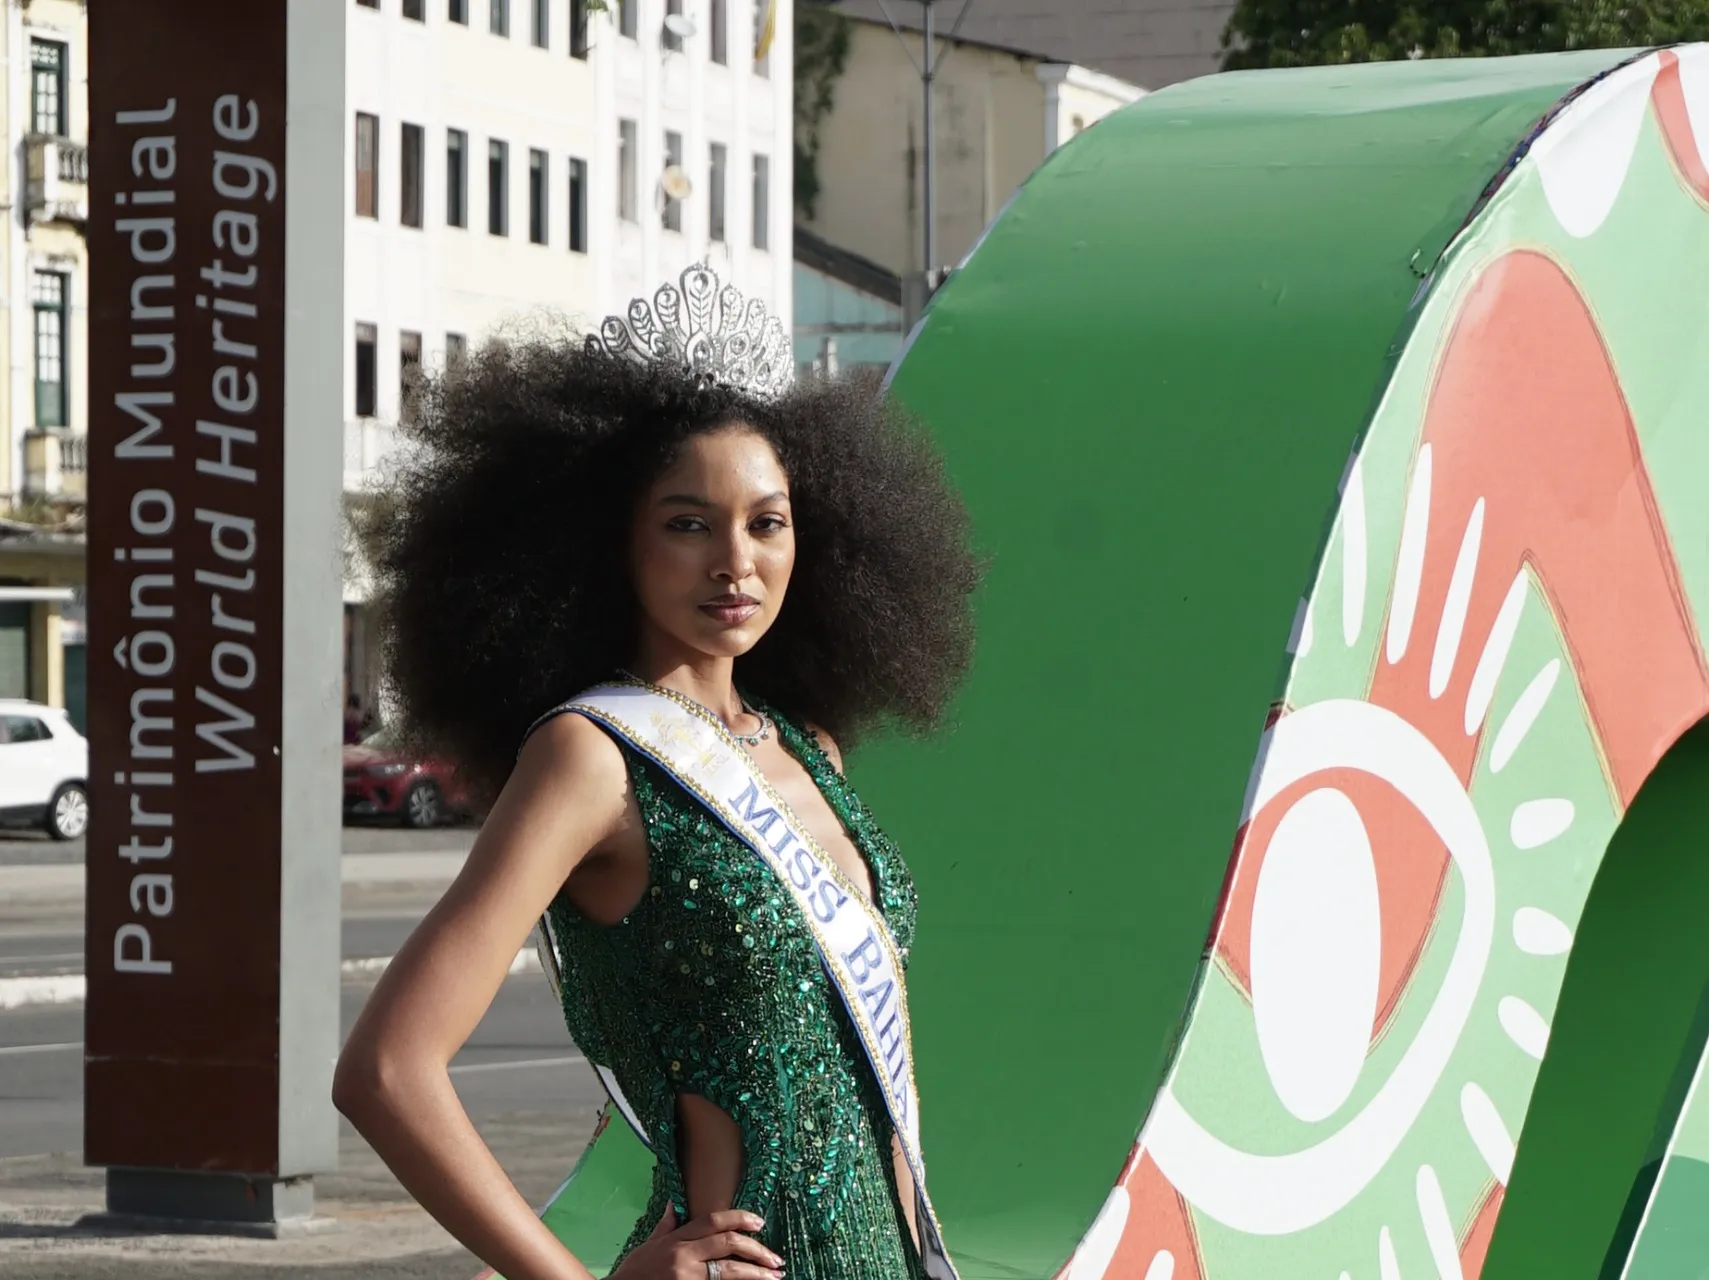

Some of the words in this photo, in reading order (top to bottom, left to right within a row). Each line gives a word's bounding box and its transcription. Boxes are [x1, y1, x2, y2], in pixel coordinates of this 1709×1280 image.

[114, 98, 176, 458] Mundial
[195, 94, 277, 483] Heritage
[113, 489, 175, 974] Patrimônio
[194, 508, 257, 772] World
[728, 776, 848, 923] MISS
[841, 926, 908, 1130] BAHIA
